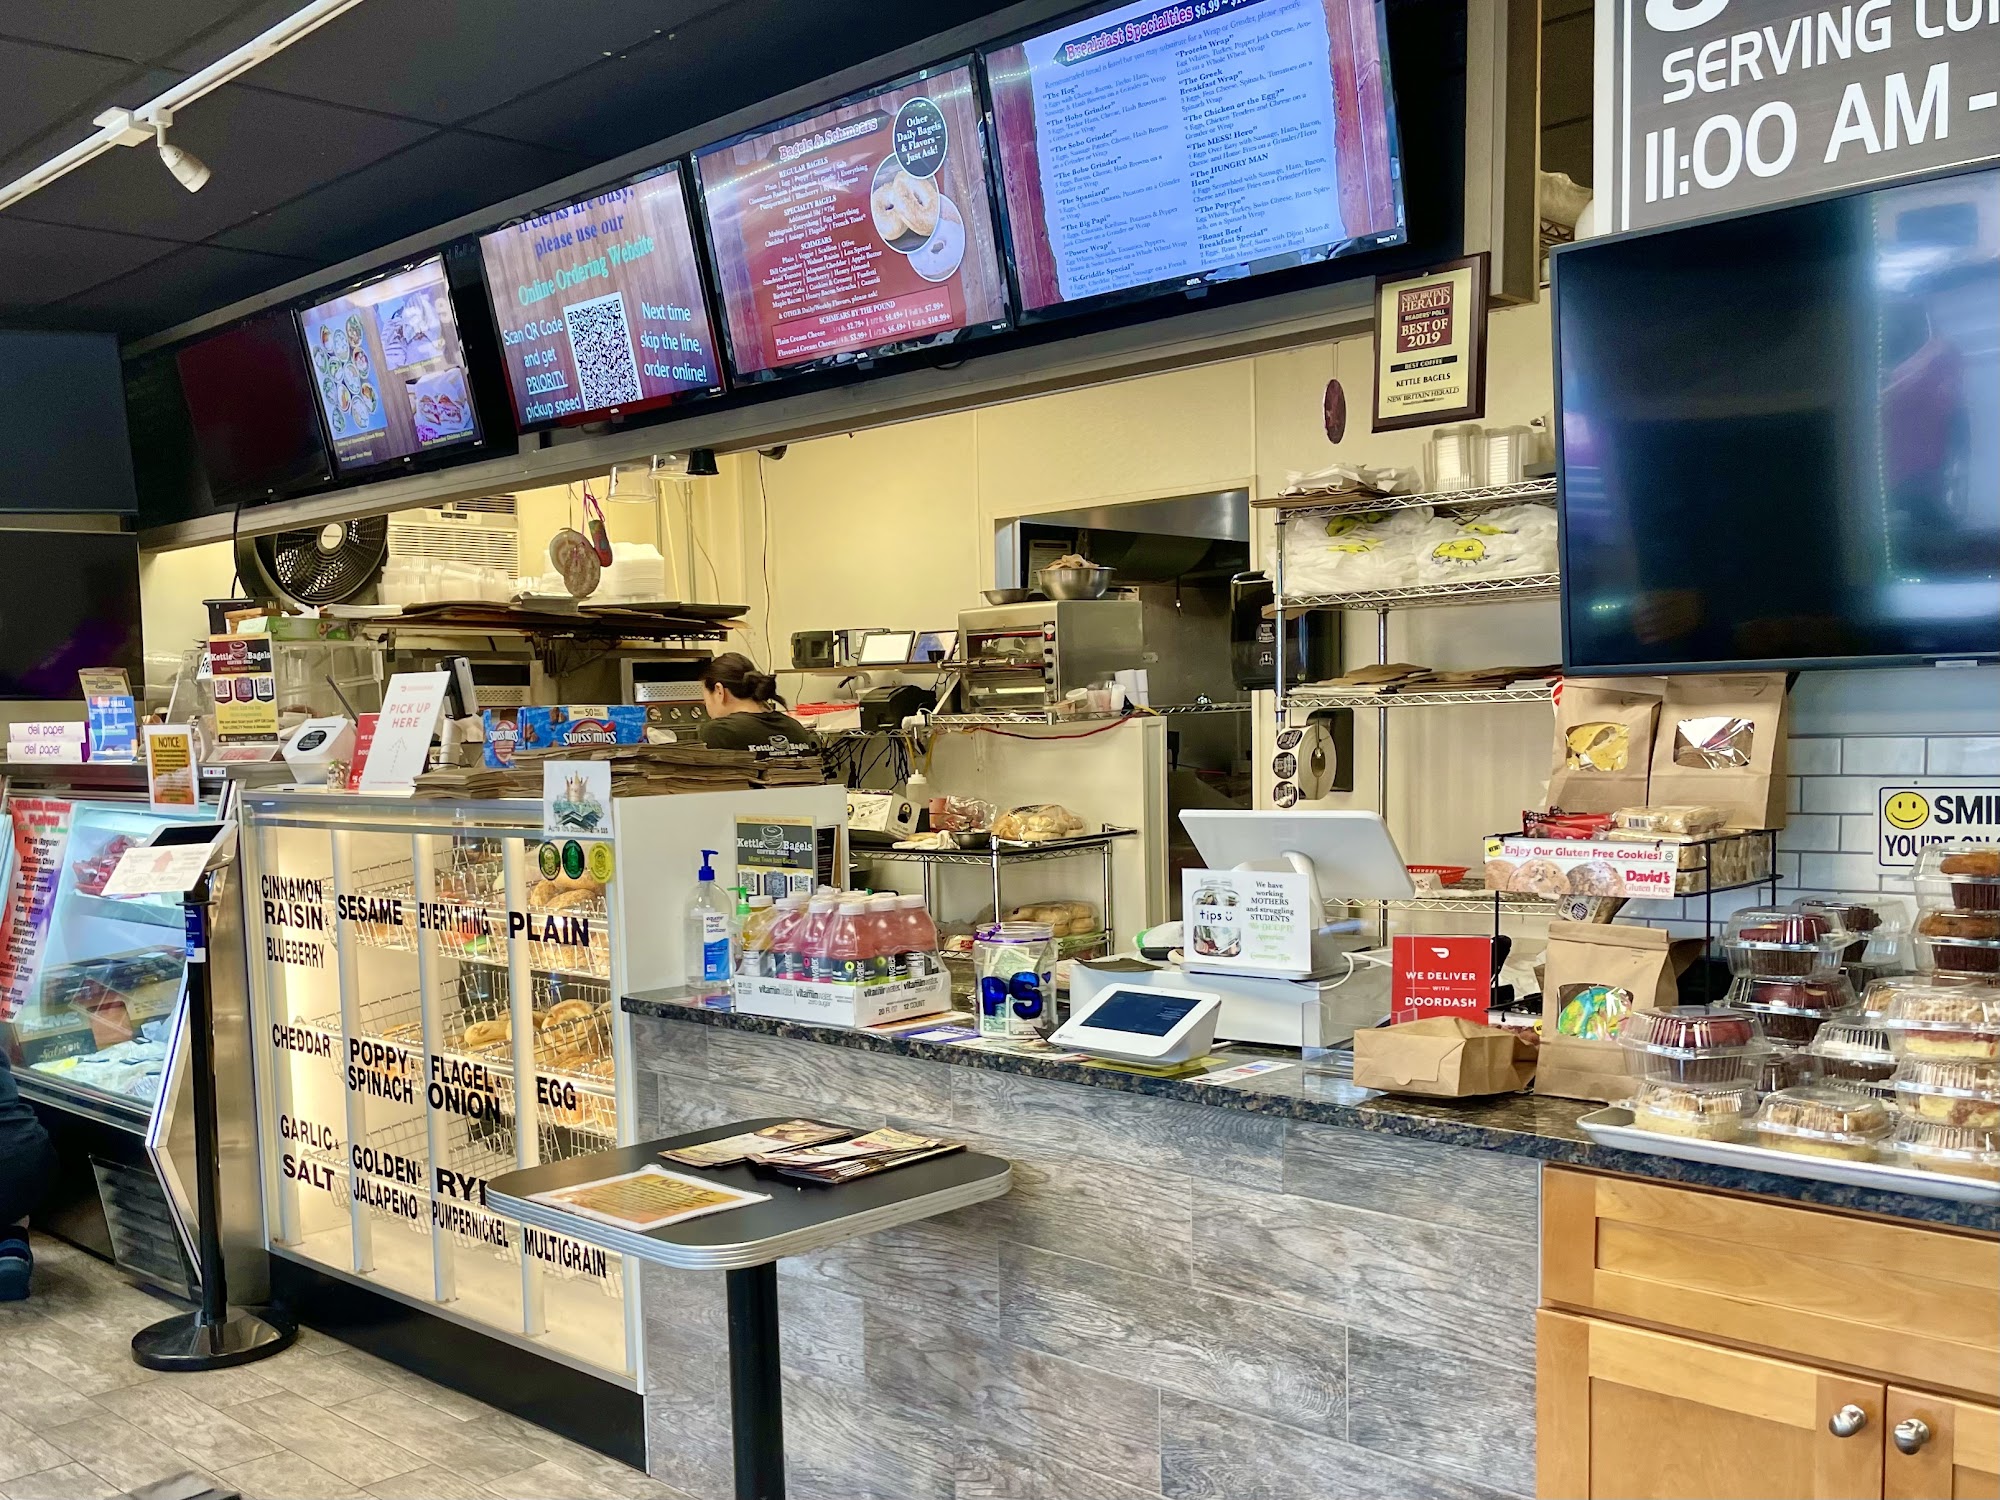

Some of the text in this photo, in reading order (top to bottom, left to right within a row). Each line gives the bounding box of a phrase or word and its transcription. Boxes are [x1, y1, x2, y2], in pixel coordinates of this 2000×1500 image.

[1066, 2, 1219, 60] Breakfast Specialties $6.99
[1662, 0, 1892, 103] SERVING
[1915, 0, 2000, 38] LU
[1180, 80, 1216, 95] Breakfast
[906, 114, 928, 128] Other
[897, 122, 941, 143] Daily Bagels
[1207, 134, 1232, 145] MESS!
[1646, 62, 1949, 203] 11:00 AM
[779, 138, 813, 159] Bagels
[901, 136, 935, 152] & Flavors
[906, 145, 938, 165] Just Ask!
[1211, 153, 1269, 174] HUNGRY MAN
[779, 157, 829, 178] REGULAR BAGELS
[783, 195, 836, 216] SPECIALTY BAGELS
[535, 214, 624, 261] please use our
[1199, 237, 1235, 250] Breakfast
[518, 235, 655, 306] Online Ordering Website
[642, 302, 691, 322] Next time
[860, 306, 872, 315] THE
[873, 300, 896, 313] POUND
[1401, 294, 1450, 313] HERALD
[1432, 308, 1446, 318] POLL
[503, 317, 564, 346] Scan QR Code
[1401, 318, 1449, 337] BEST OF
[640, 332, 703, 355] skip the line,
[1407, 331, 1441, 348] 2019
[524, 348, 557, 368] and get
[1405, 361, 1419, 369] BEST
[525, 370, 568, 392] PRIORITY
[644, 361, 708, 383] order online!
[1396, 372, 1451, 388] KETTLE BAGELS
[1403, 391, 1430, 401] BRITAIN
[1431, 386, 1460, 397] HERALD
[525, 394, 580, 422] pickup speed
[211, 651, 270, 661] Kettle Bagels
[390, 703, 415, 714] PICK
[416, 702, 431, 713] UP
[28, 724, 64, 736] deli paper
[392, 717, 419, 728] HERE
[25, 744, 61, 756] deli paper
[737, 838, 812, 853] Kettle Bagels
[1504, 845, 1662, 860] Enjoy Our Gluten Free Cookies!
[1267, 881, 1283, 889] have
[1625, 870, 1670, 884] David's
[261, 874, 323, 901] CINNAMON
[1256, 890, 1283, 898] working
[1624, 884, 1671, 894] Gluten Free
[264, 900, 324, 931] RAISIN
[337, 894, 404, 926] SESAME
[419, 902, 489, 936] EVERYTHING
[1200, 910, 1222, 924] tips
[1250, 914, 1290, 922] STUDENTS
[1260, 907, 1294, 916] struggling
[508, 911, 590, 948] PLAIN
[267, 937, 325, 969] BLUEBERRY
[1405, 970, 1476, 981] WE DELIVER
[1404, 996, 1477, 1008] DOORDASH
[272, 1023, 331, 1058] CHEDDAR
[349, 1037, 408, 1075] POPPY
[347, 1064, 414, 1105] SPINACH
[431, 1055, 494, 1095] FLAGEL
[427, 1082, 501, 1123] ONION
[537, 1076, 577, 1111] EGG
[280, 1114, 333, 1151] GARLIC
[282, 1154, 335, 1192] SALT
[352, 1145, 417, 1185] GOLDEN
[353, 1176, 418, 1220] JALAPENO
[655, 1179, 715, 1198] NOTICE
[432, 1200, 509, 1249] PUMPERNICKEL
[524, 1227, 607, 1280] MULTIGRAIN
